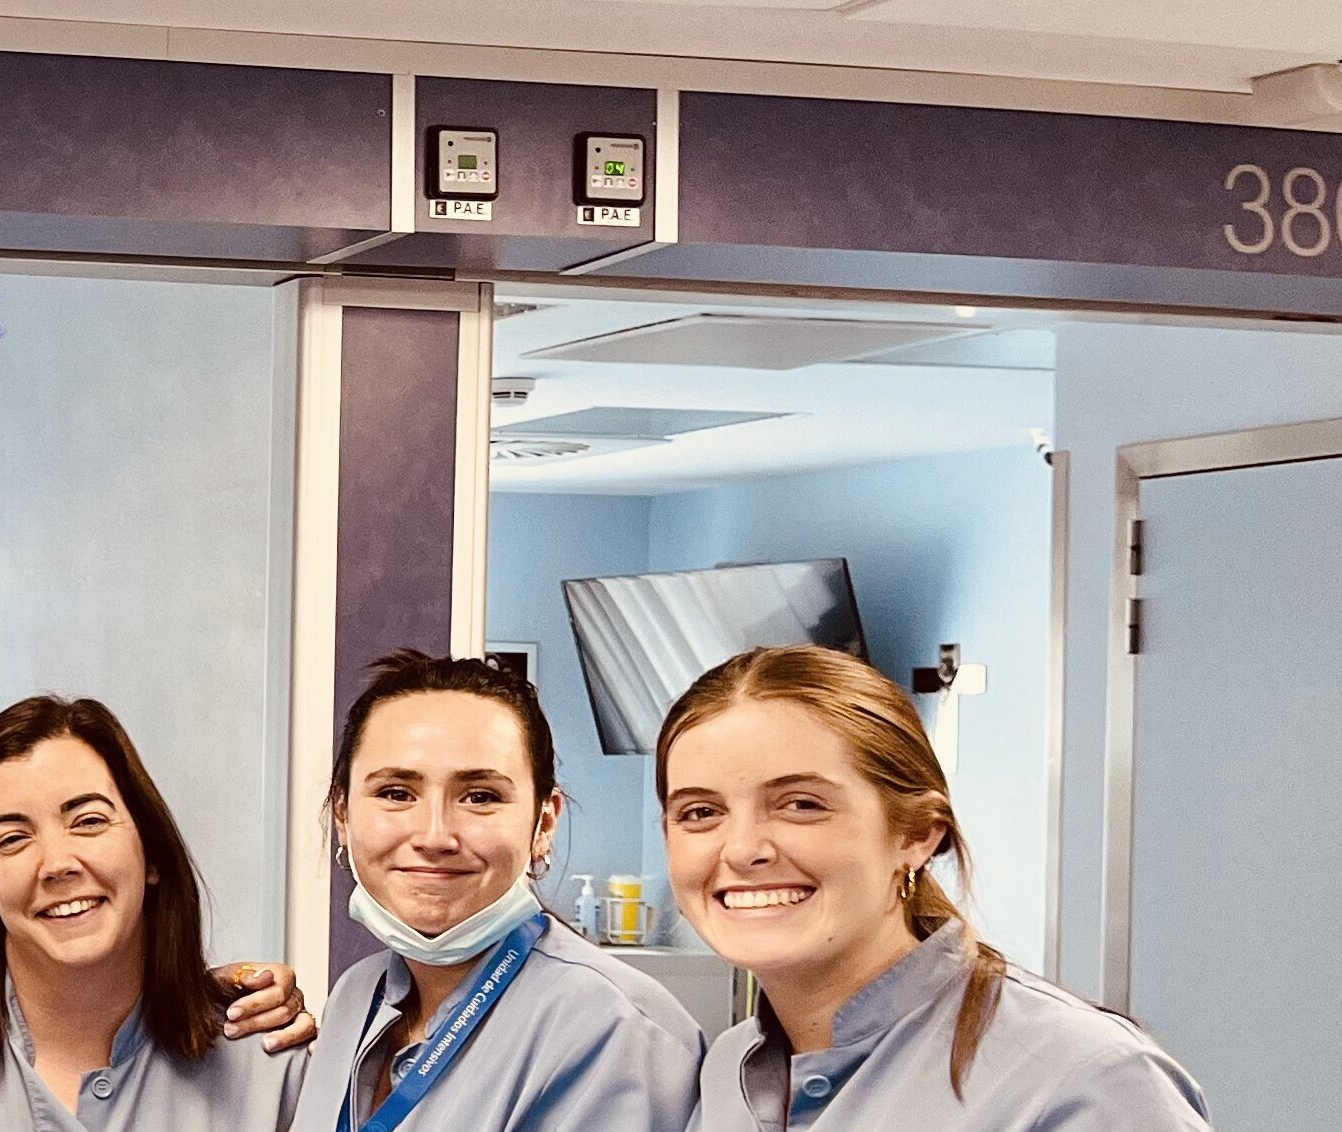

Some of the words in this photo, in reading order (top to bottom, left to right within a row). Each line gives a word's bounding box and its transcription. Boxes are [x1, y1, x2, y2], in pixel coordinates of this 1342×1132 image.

[1223, 163, 1342, 257] 38
[481, 980, 494, 994] de
[490, 949, 519, 983] Unidad
[451, 992, 487, 1034] Cuidados
[418, 1031, 457, 1077] Intensivos
